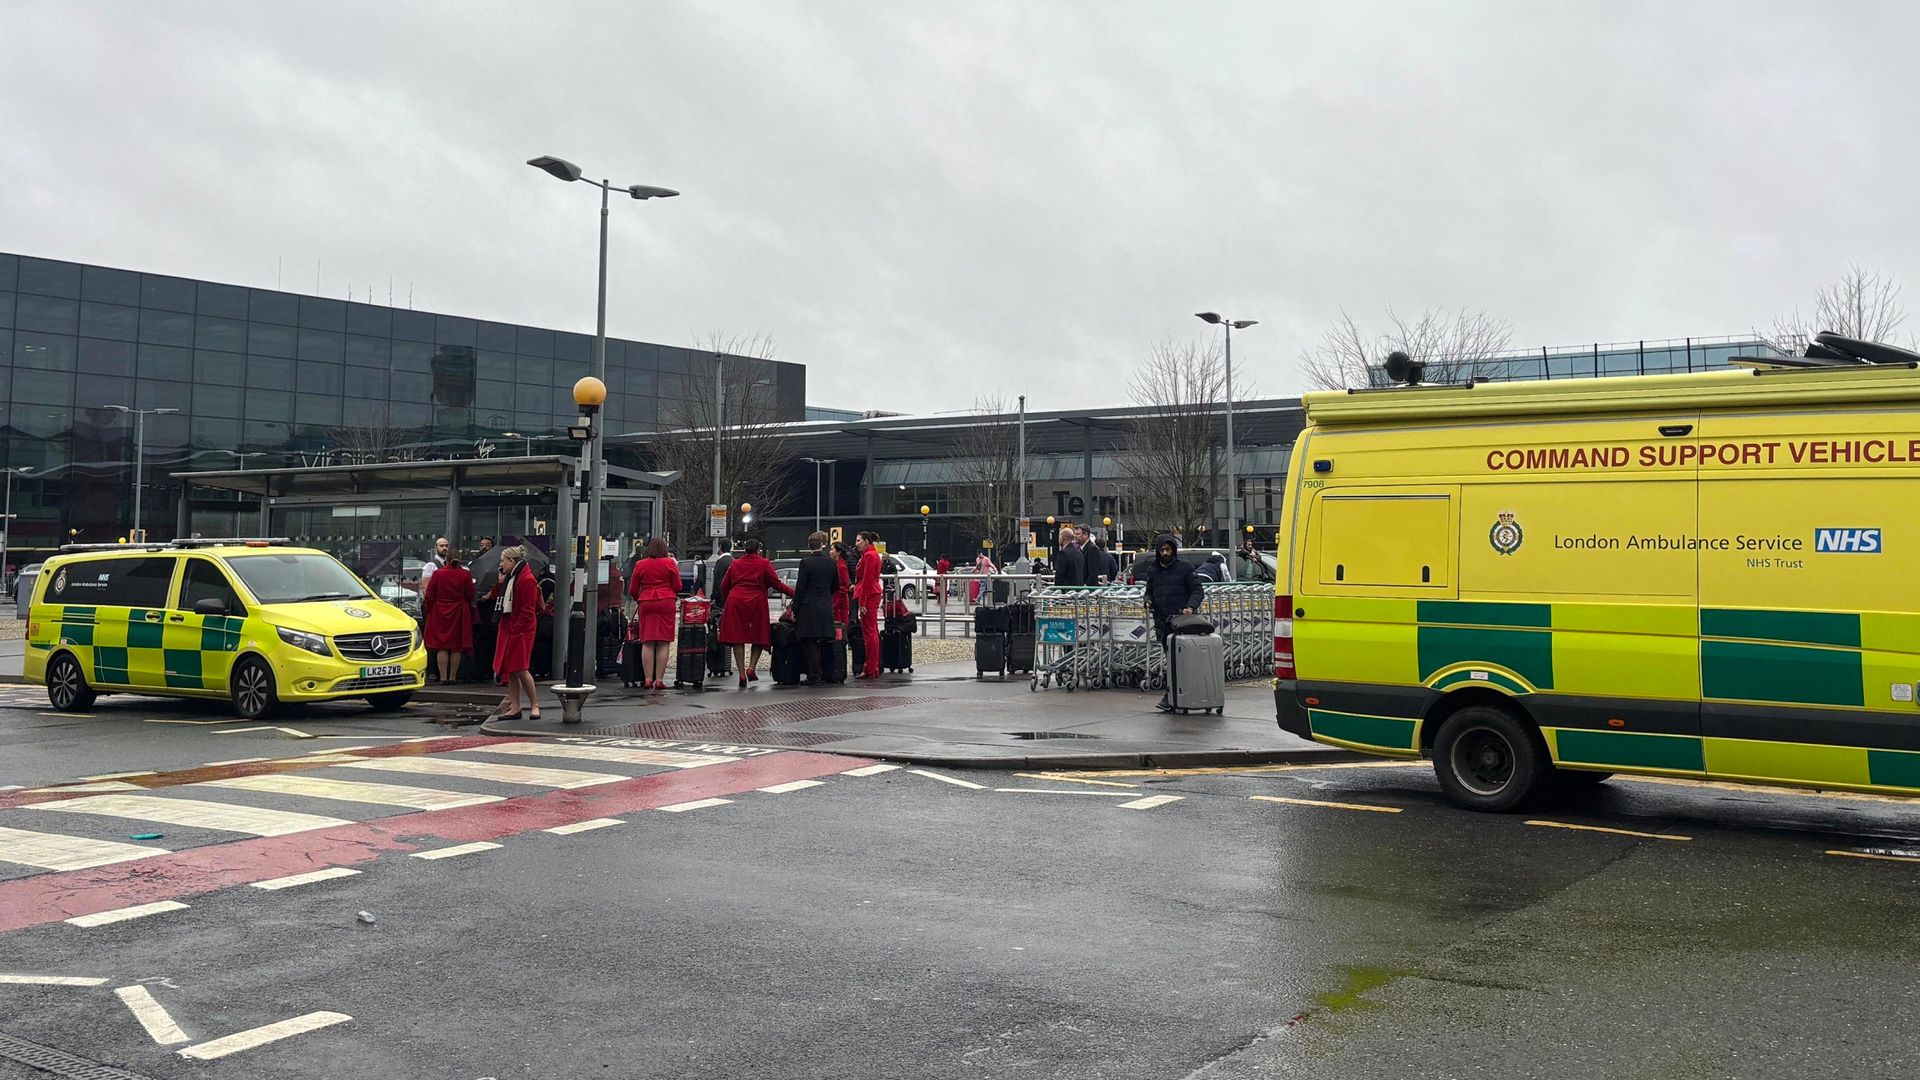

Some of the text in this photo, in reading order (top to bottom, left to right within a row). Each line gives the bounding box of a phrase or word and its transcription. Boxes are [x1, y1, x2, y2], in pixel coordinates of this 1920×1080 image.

[1486, 440, 1920, 471] COMMAND SUPPORT VEHICLE
[1303, 480, 1325, 489] 7908
[1052, 489, 1184, 516] Temin
[1554, 534, 1803, 551] London Ambulance Service
[1816, 529, 1879, 552] NHS
[1746, 558, 1804, 569] NHS Trust
[98, 573, 111, 581] NHS
[367, 667, 387, 676] LK25
[677, 743, 779, 757] LOOK
